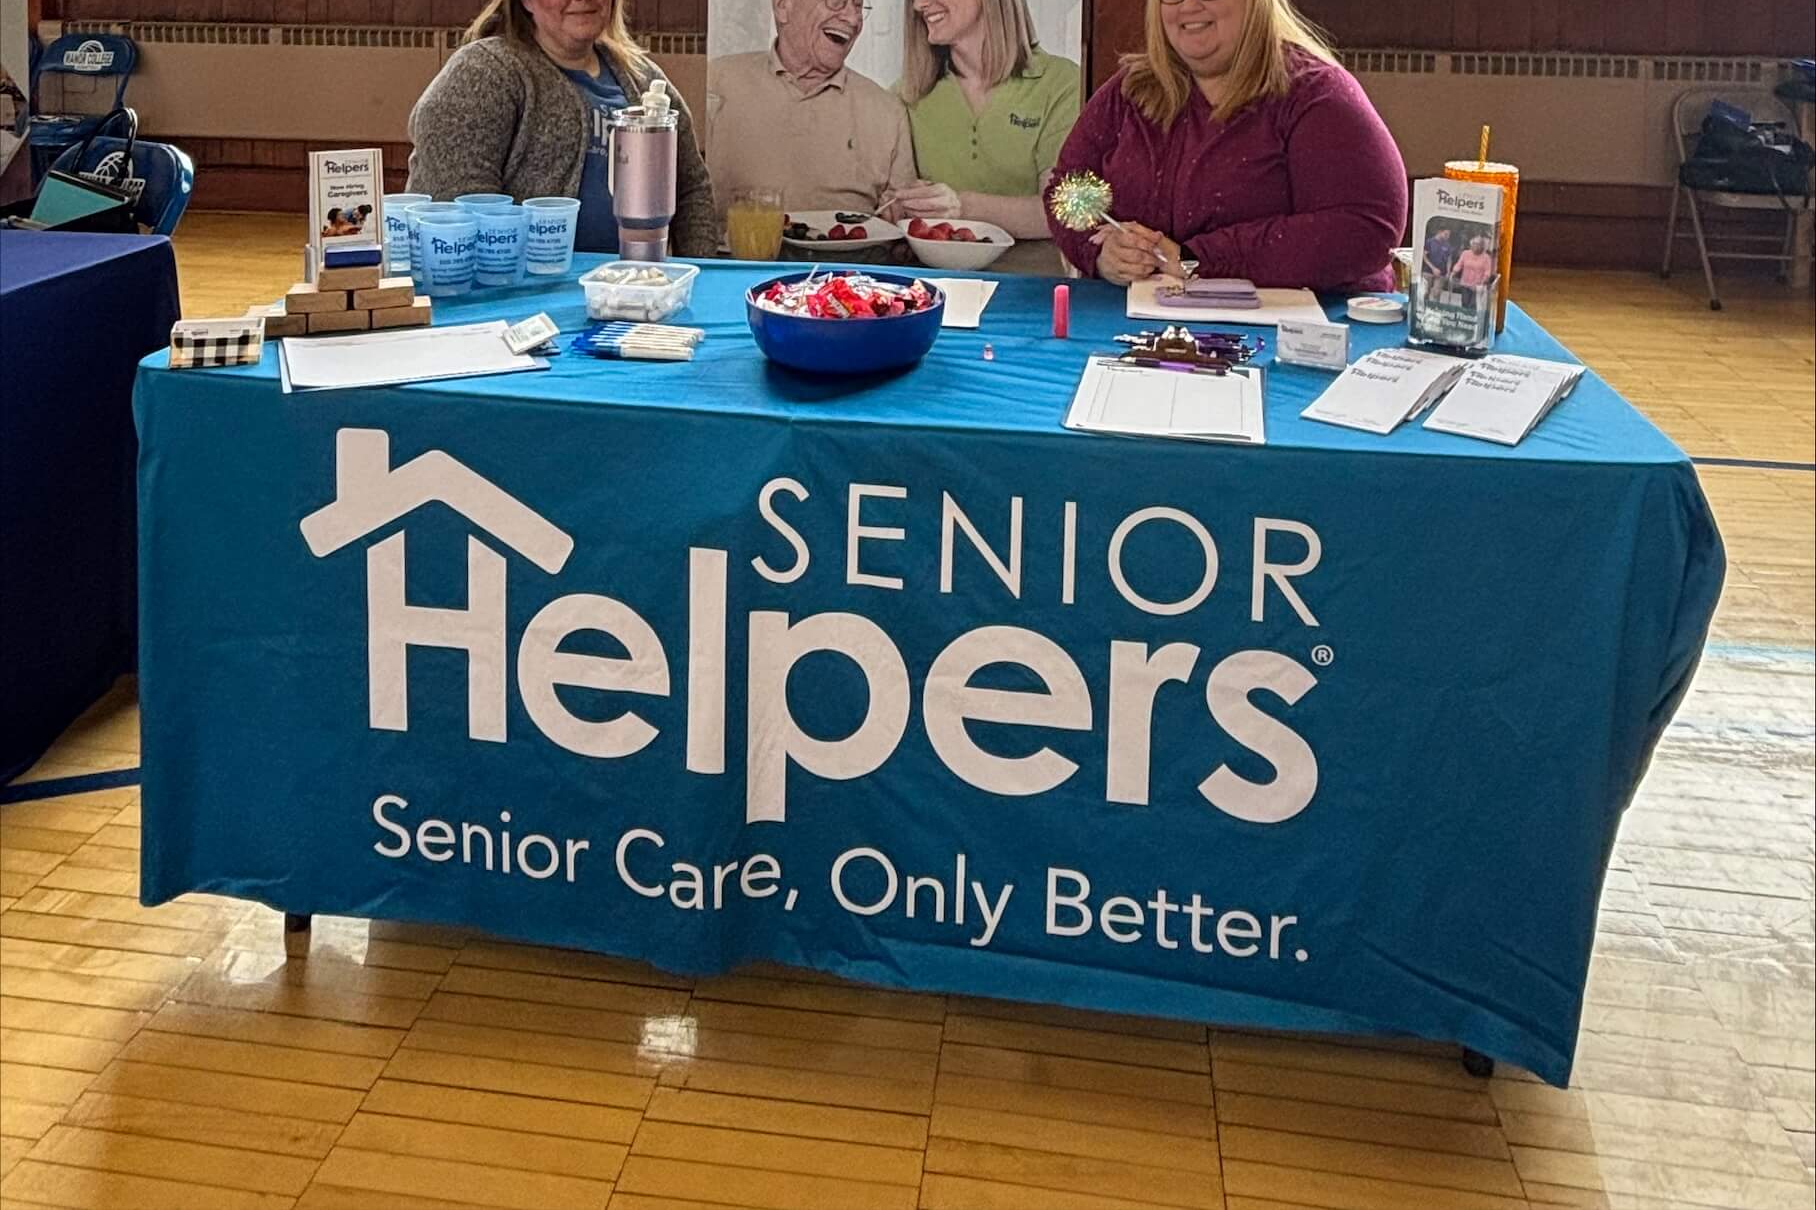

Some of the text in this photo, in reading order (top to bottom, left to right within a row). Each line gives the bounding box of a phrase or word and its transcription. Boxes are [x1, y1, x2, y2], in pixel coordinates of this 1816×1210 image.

[326, 163, 369, 175] Helpers
[1438, 192, 1485, 210] Helpers
[528, 223, 567, 236] elpers
[750, 476, 1323, 628] SENIOR
[371, 794, 1310, 963] Senior Care, Only Better.
